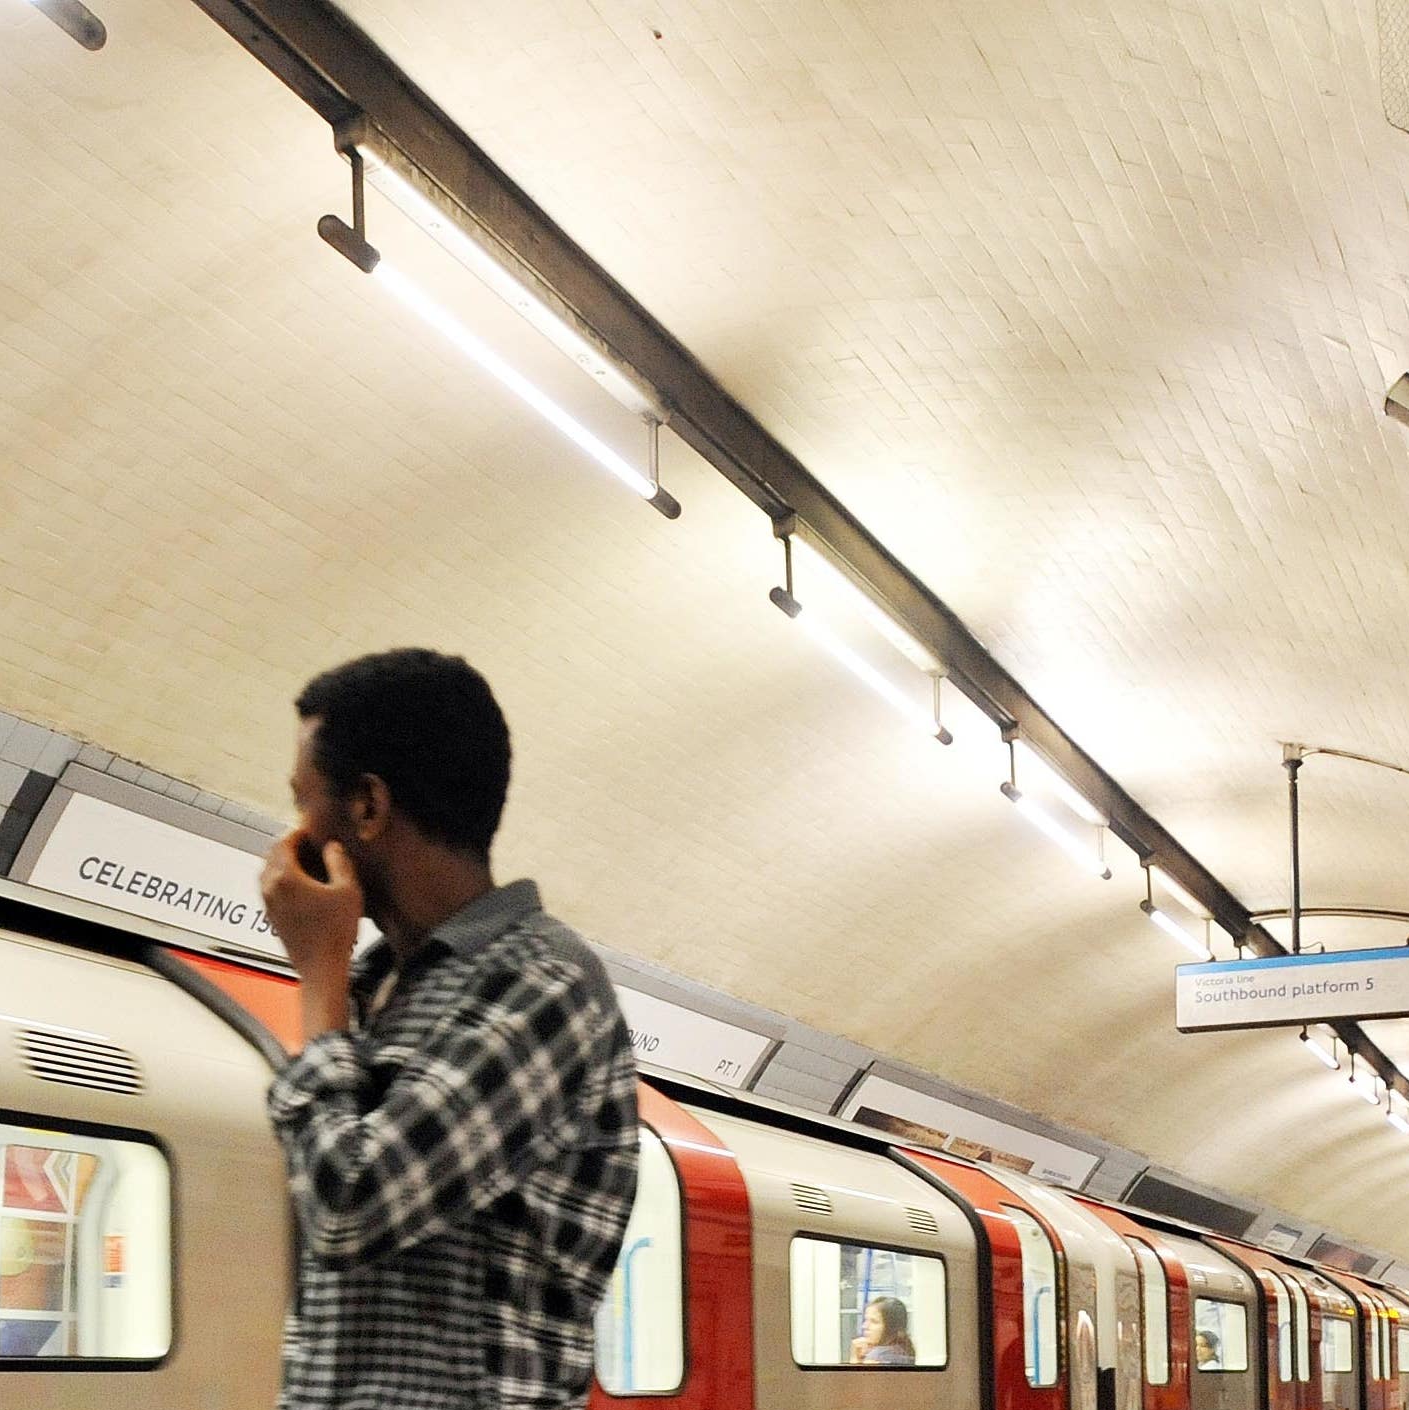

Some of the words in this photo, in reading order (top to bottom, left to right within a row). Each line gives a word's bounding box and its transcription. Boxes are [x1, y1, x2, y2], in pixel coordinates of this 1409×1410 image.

[78, 856, 247, 925] CELEBRATING
[1195, 977, 1234, 986] Victoria
[1236, 975, 1255, 984] line
[1195, 984, 1287, 1003] Southbound
[1292, 980, 1359, 999] platform
[1365, 977, 1374, 991] 5
